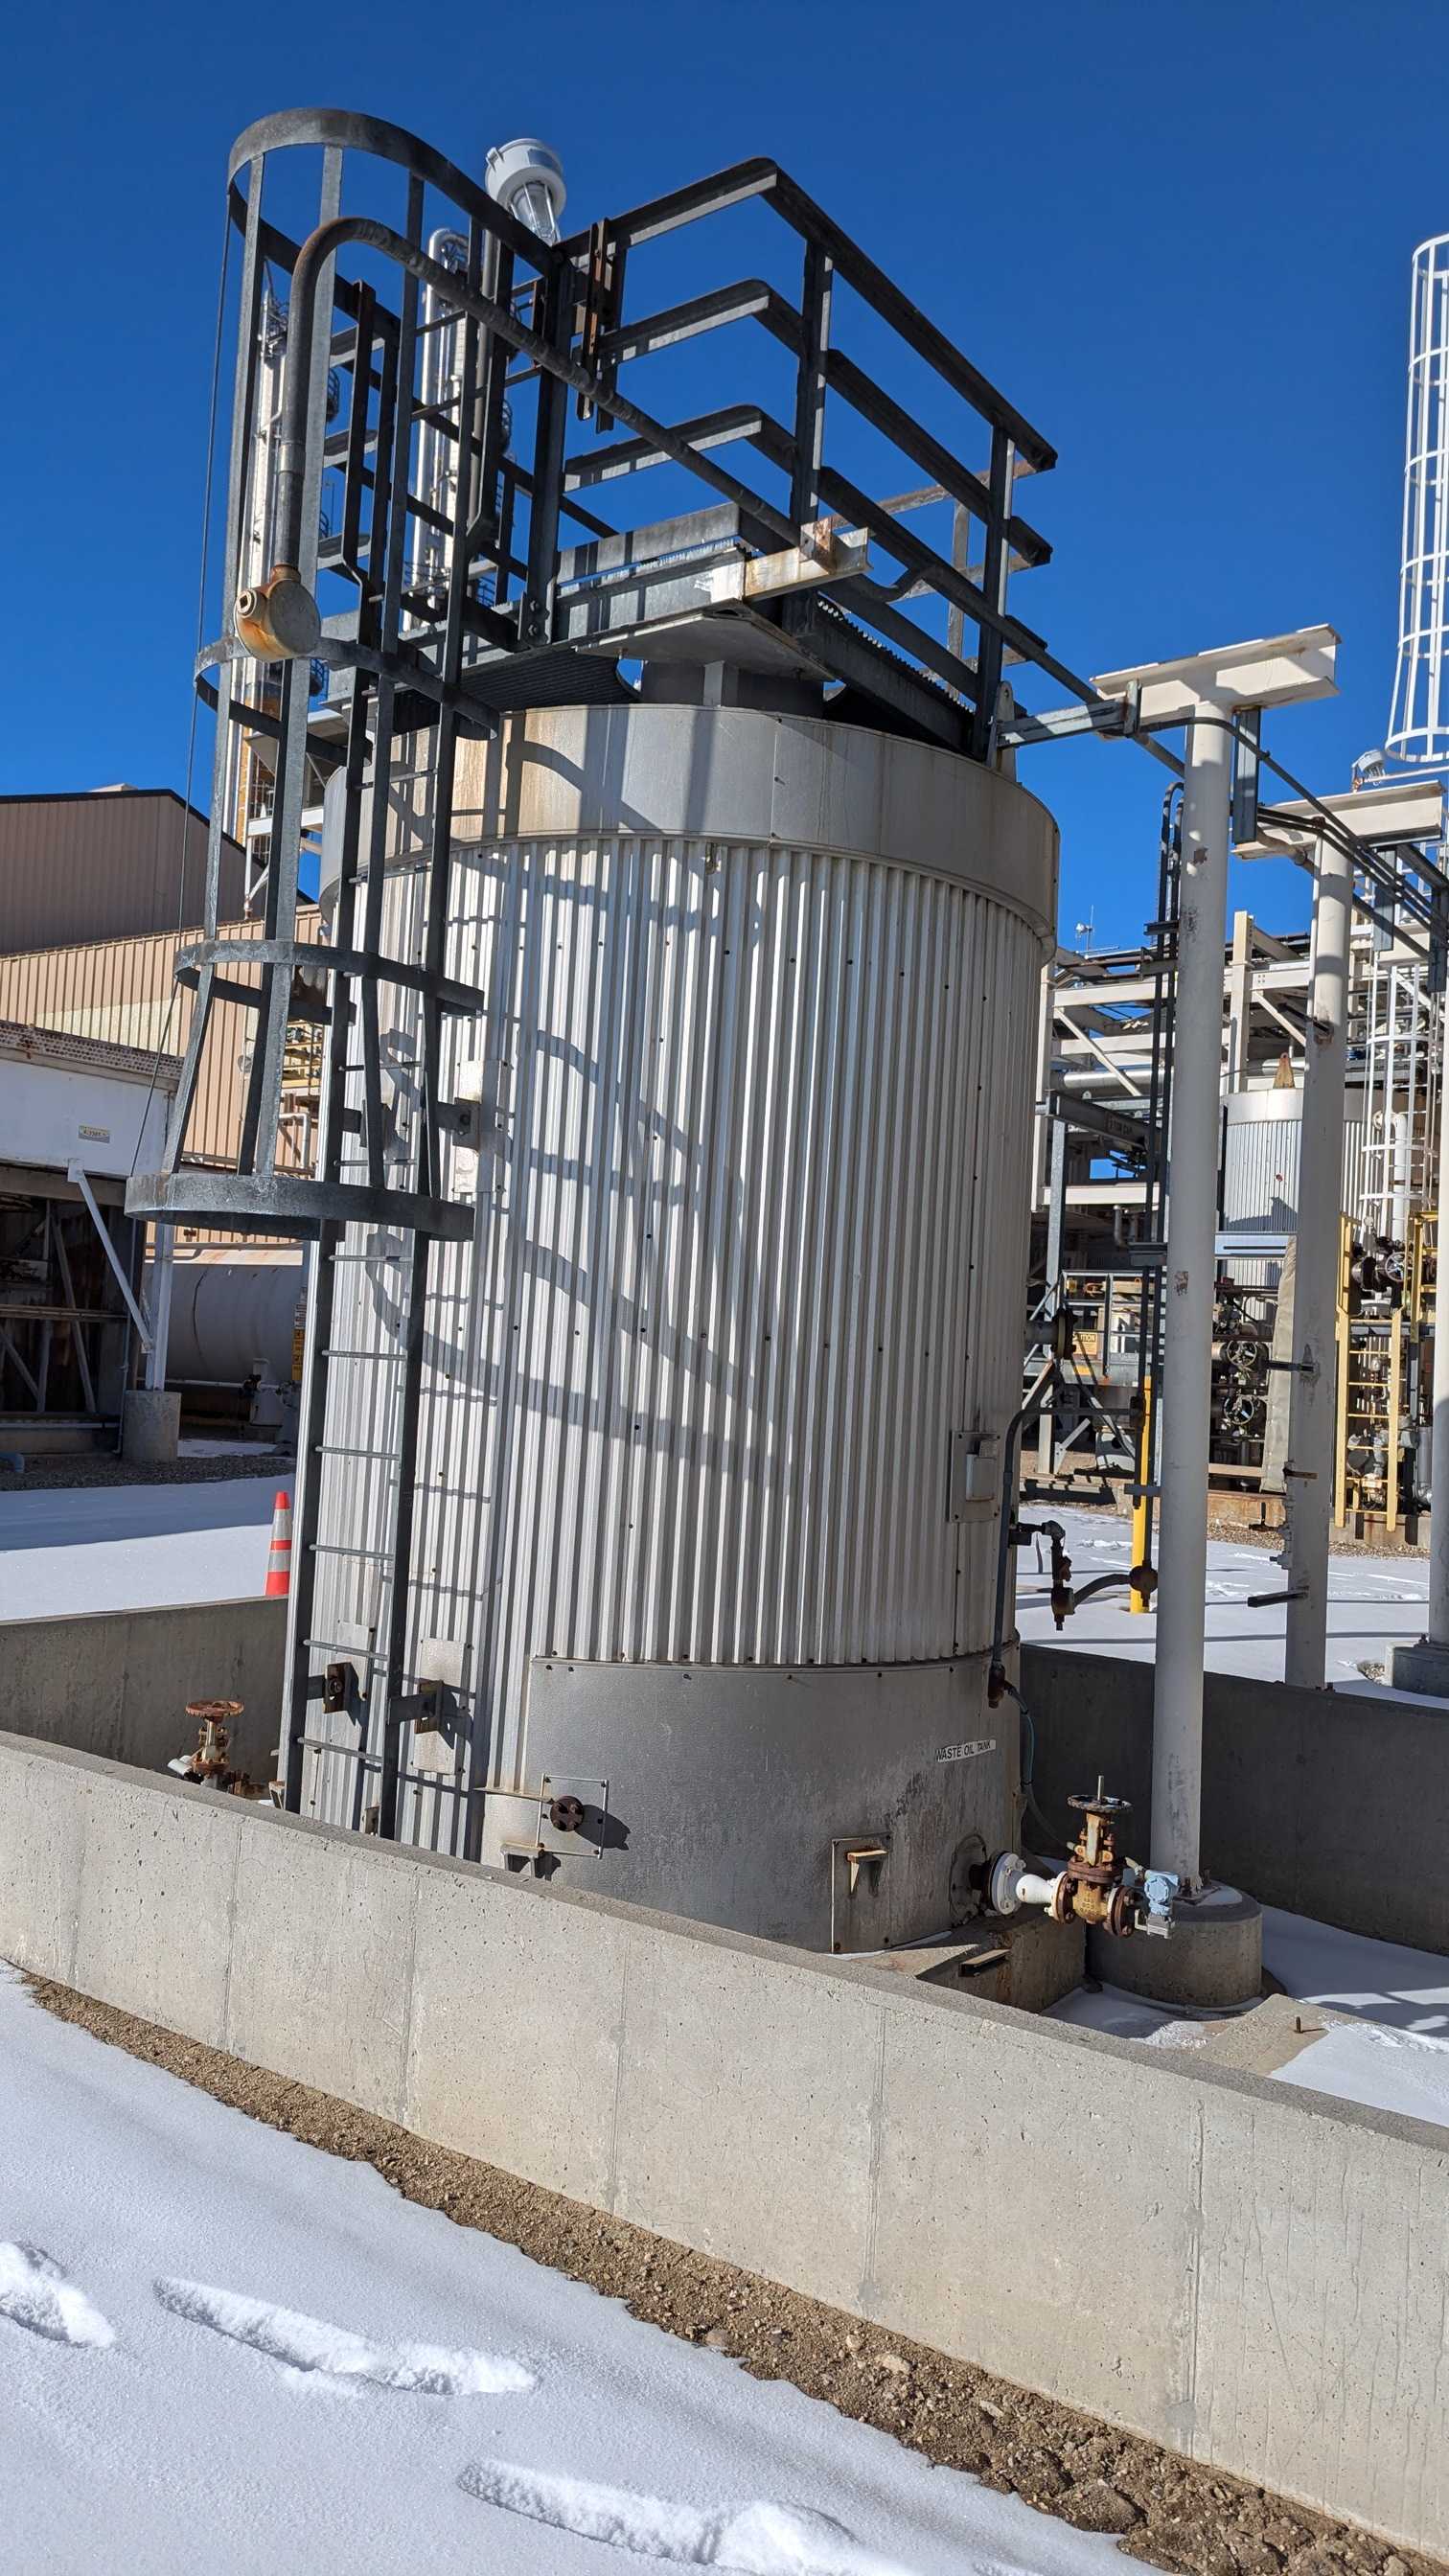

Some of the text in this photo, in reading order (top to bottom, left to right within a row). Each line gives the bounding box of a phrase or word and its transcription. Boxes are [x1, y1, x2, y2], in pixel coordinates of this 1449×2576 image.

[935, 1739, 991, 1760] WASTE OIL TANK
